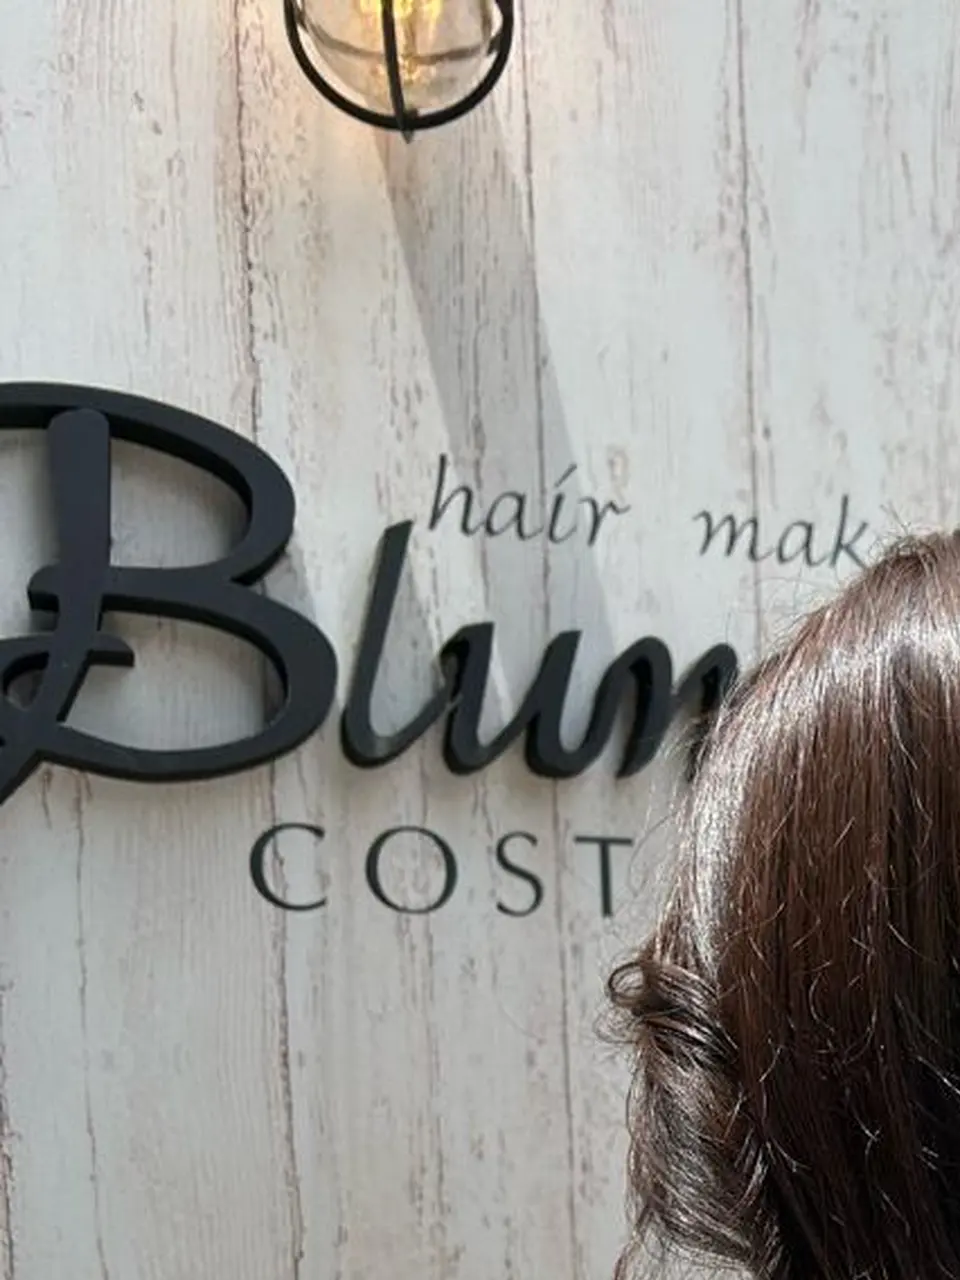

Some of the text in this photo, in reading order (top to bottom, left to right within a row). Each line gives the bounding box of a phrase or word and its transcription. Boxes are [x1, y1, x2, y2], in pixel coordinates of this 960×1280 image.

[429, 453, 869, 570] hair mak
[249, 821, 634, 918] COST
